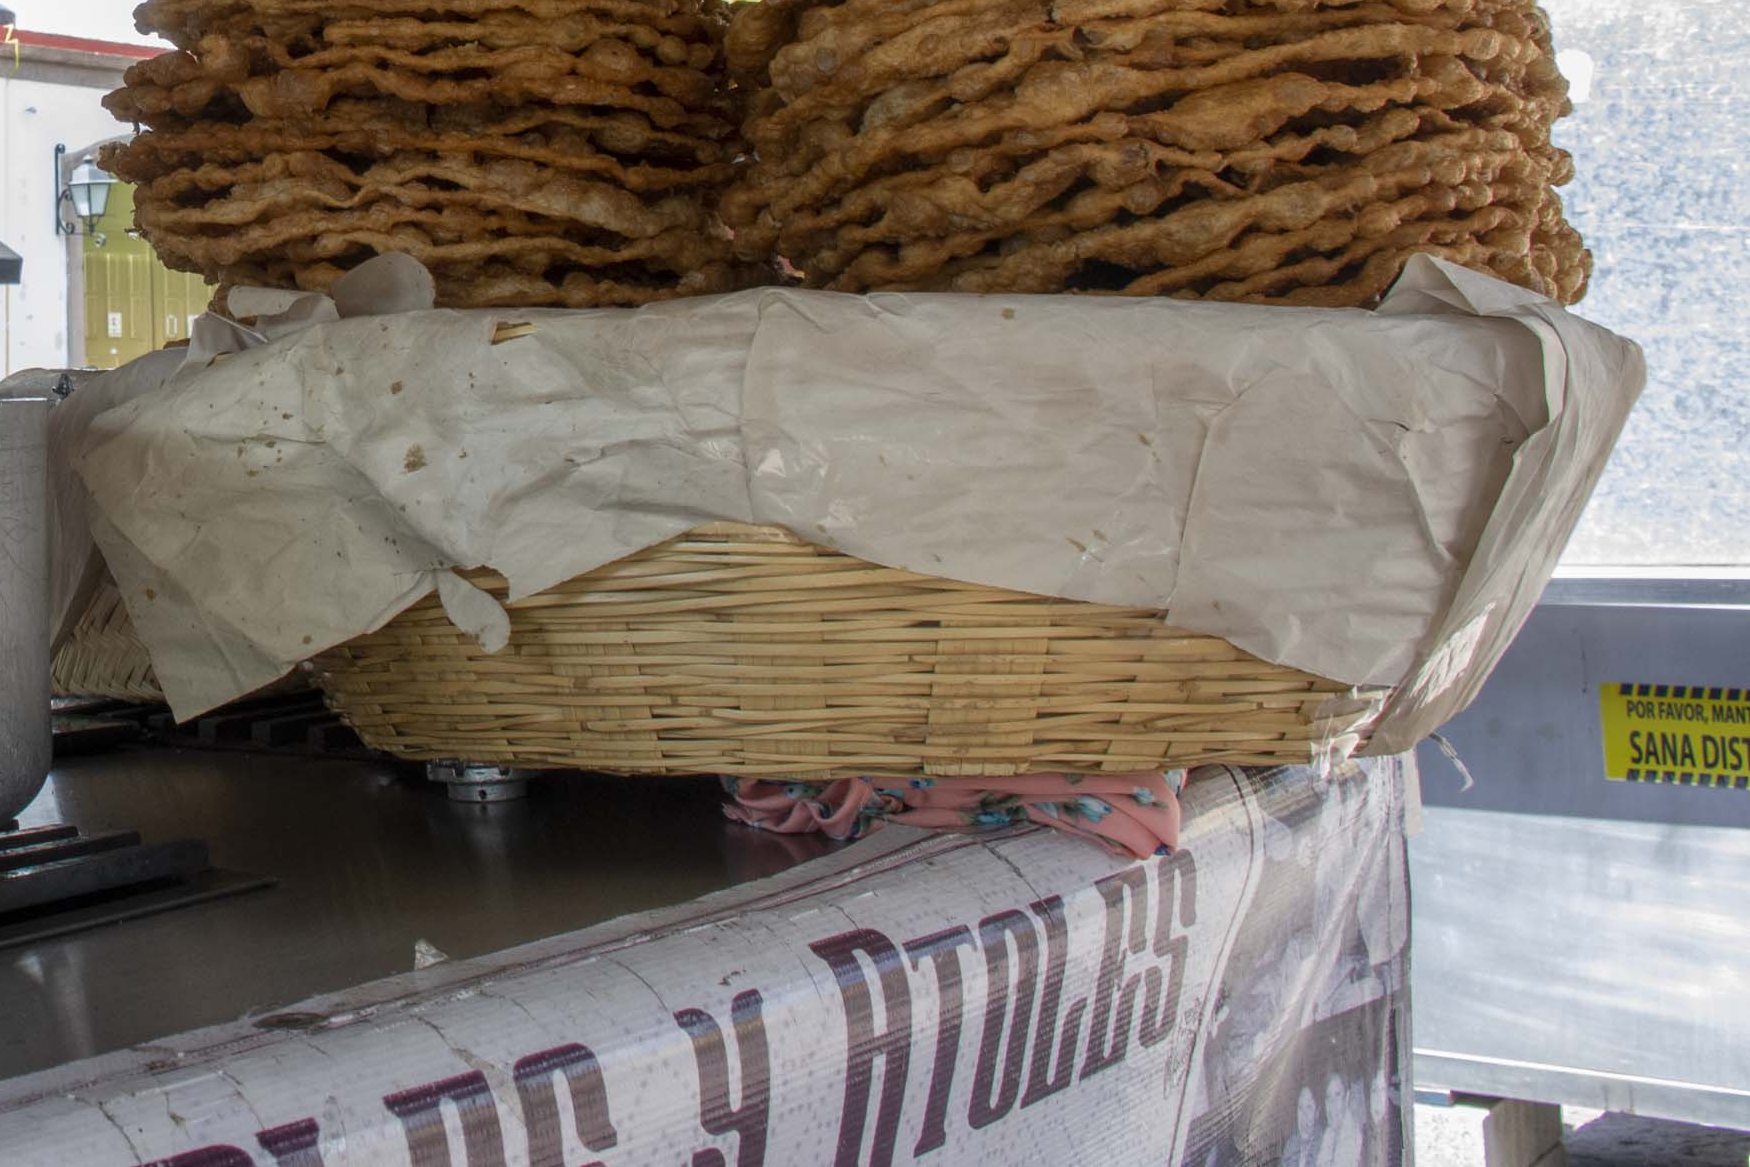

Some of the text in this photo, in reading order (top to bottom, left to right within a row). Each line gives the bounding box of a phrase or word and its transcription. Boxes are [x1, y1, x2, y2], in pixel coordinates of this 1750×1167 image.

[1626, 700, 1655, 719] POR
[1659, 701, 1709, 724] FAVOR,
[1630, 730, 1696, 768] SANA
[809, 850, 1197, 1167] ATOLES
